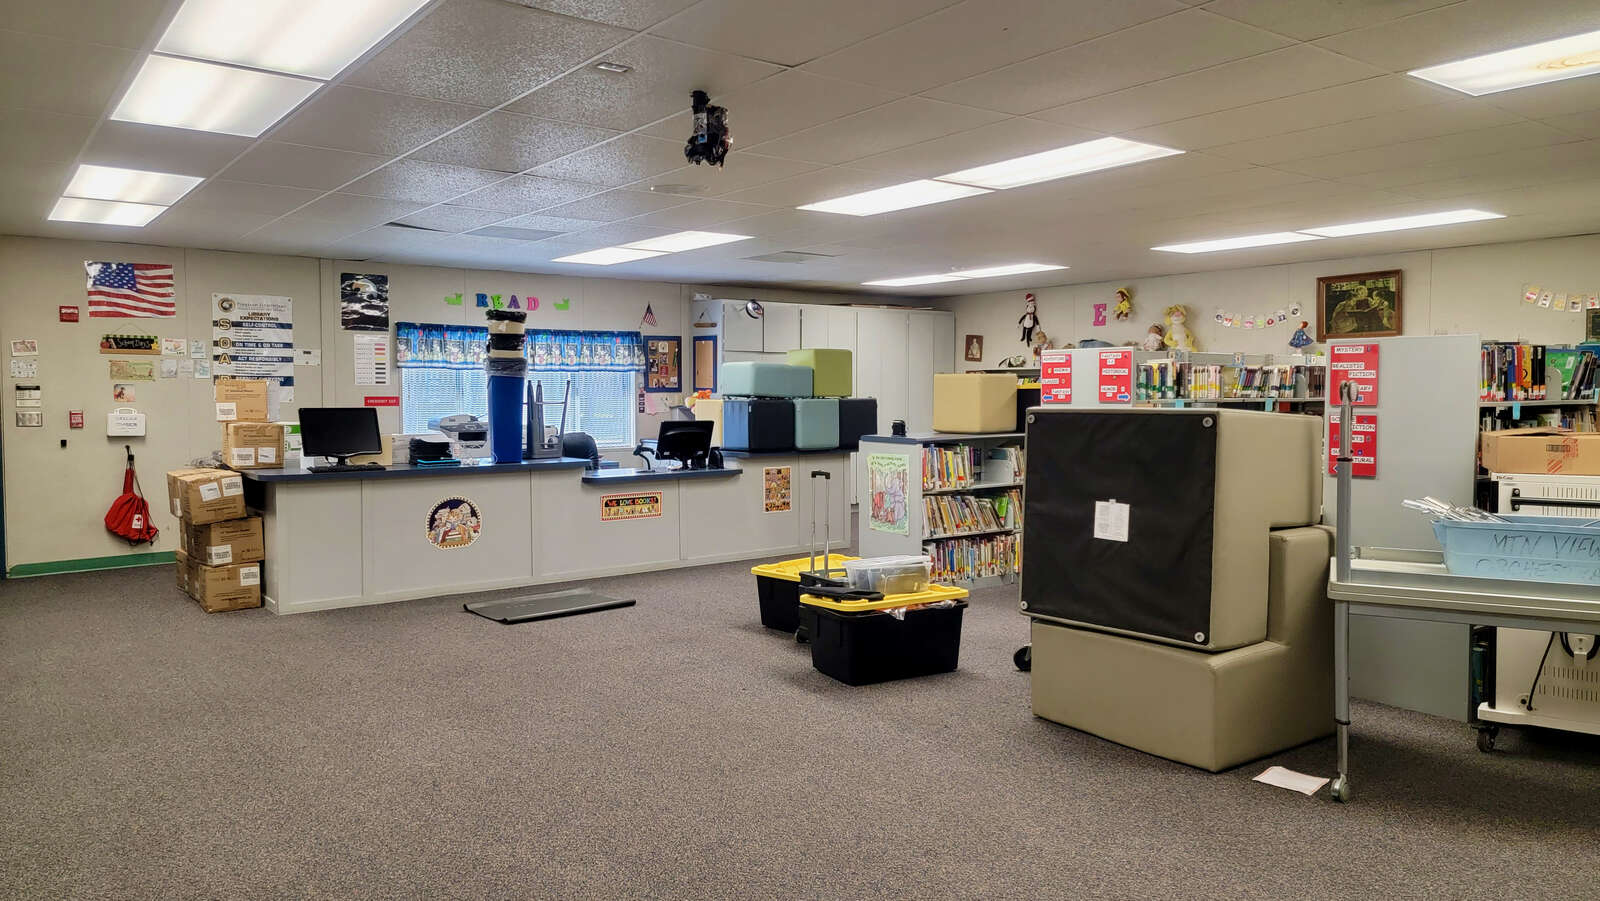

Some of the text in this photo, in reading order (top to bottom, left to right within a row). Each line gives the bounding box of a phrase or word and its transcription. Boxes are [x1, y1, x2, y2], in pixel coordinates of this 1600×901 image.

[475, 293, 540, 311] READ
[1093, 303, 1107, 326] E
[219, 318, 231, 330] S
[219, 337, 231, 349] O
[219, 353, 231, 364] A
[1493, 533, 1542, 554] MTN
